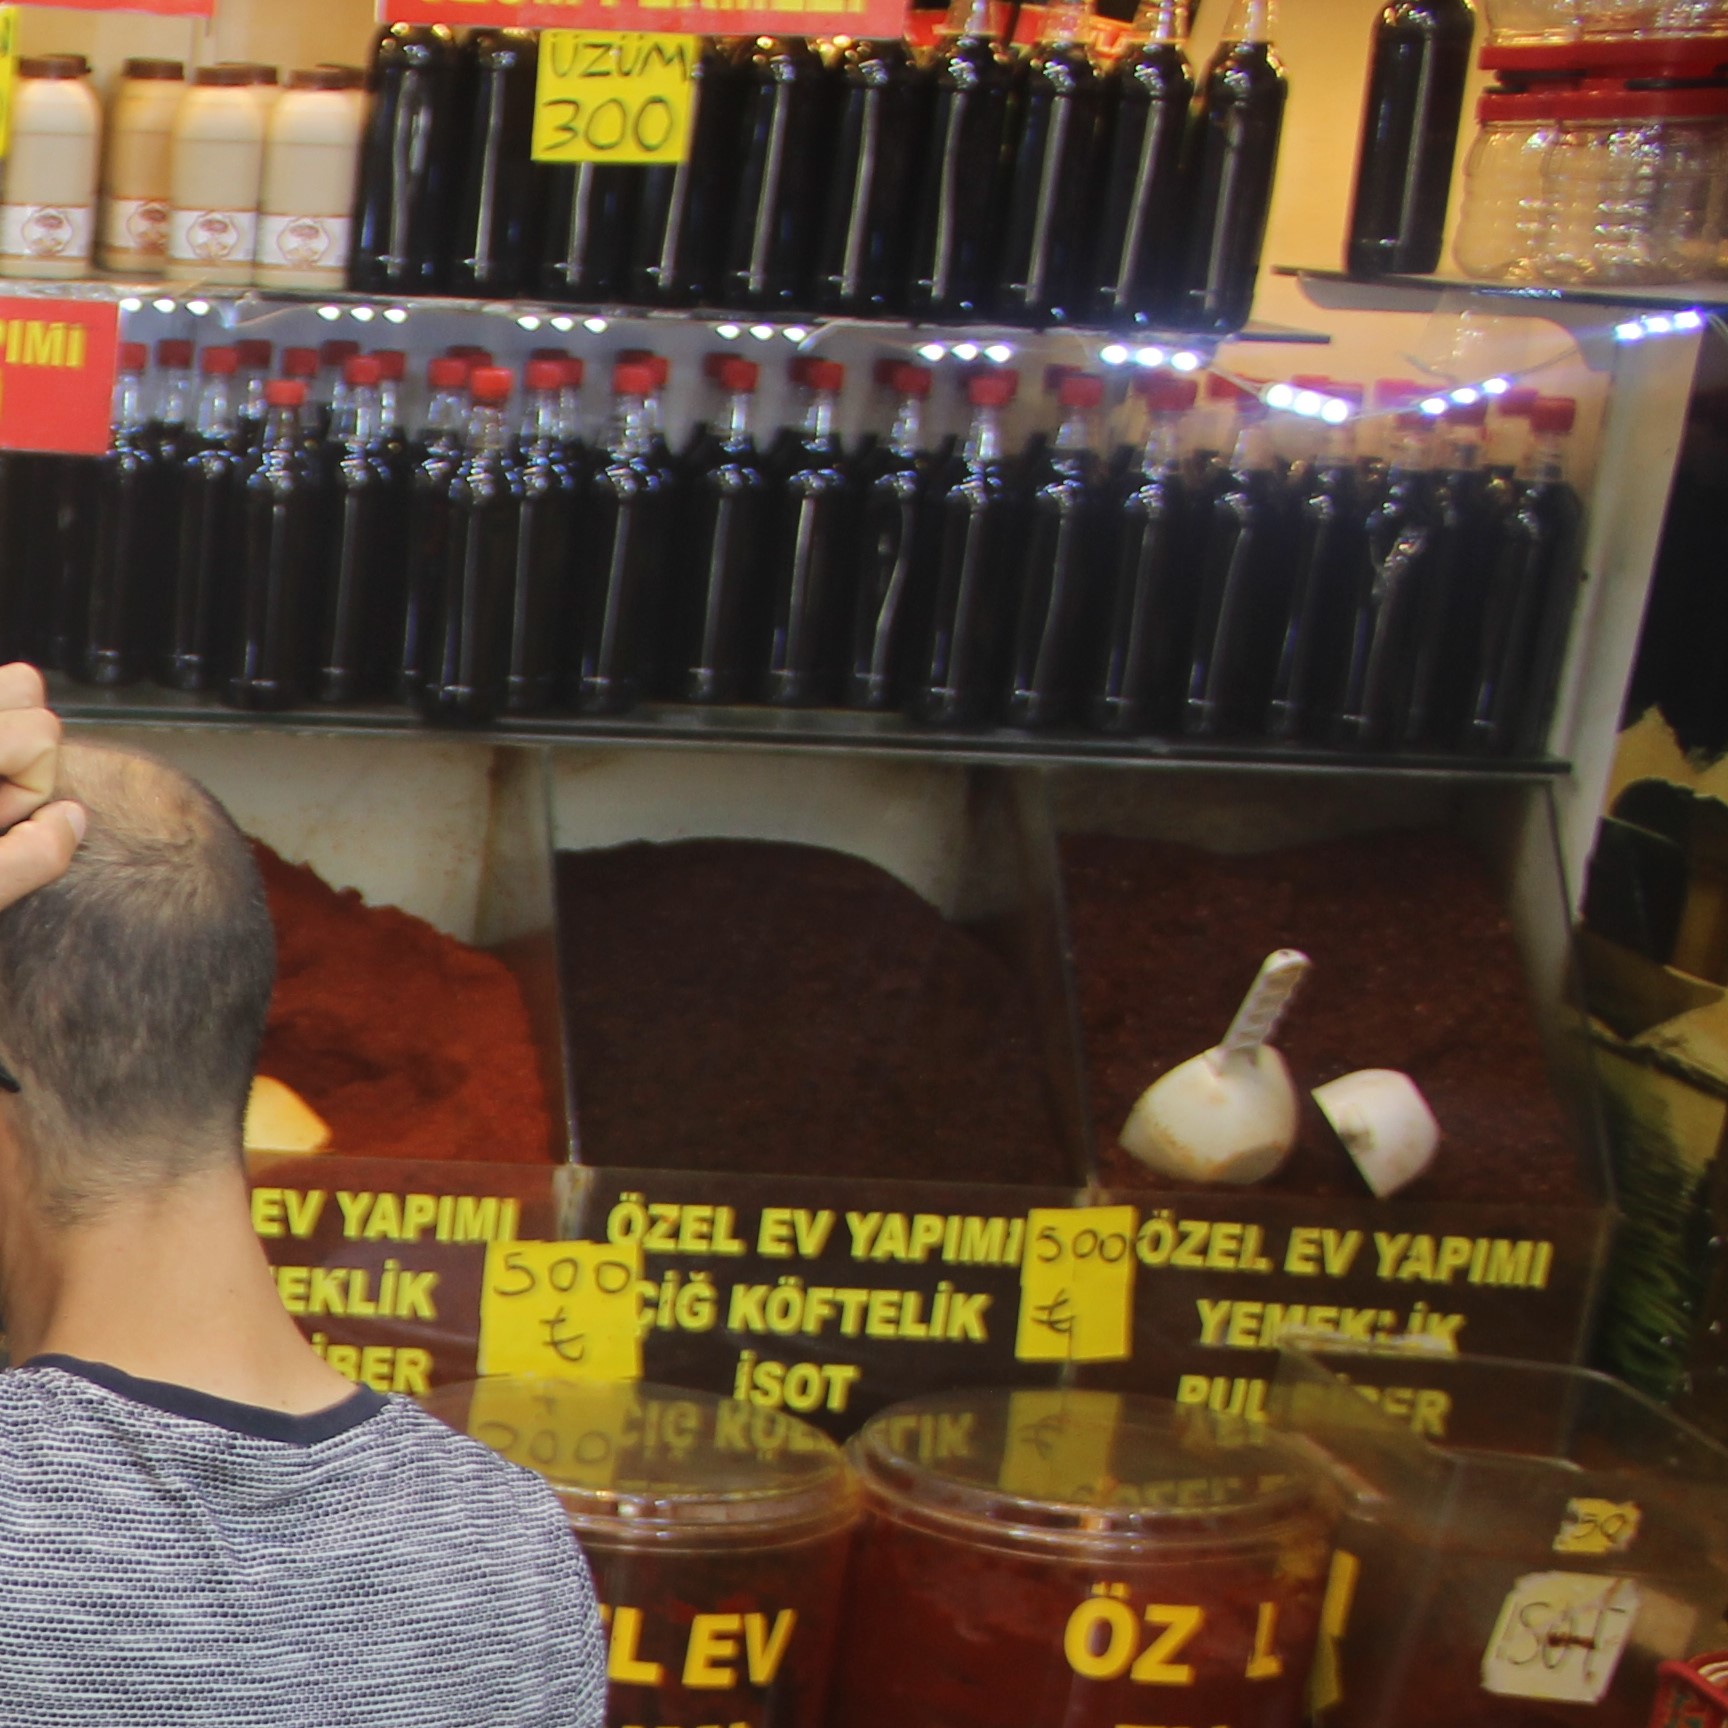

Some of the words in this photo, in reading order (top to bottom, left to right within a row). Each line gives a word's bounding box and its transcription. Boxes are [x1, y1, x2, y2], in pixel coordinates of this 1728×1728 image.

[542, 97, 674, 153] 300
[251, 1186, 323, 1239] EV
[337, 1190, 521, 1244] YAPIMI
[606, 1192, 745, 1255] ÖZEL
[756, 1207, 835, 1260] EV
[844, 1209, 1027, 1266] YAPIMI
[1032, 1229, 1129, 1266] 500
[494, 1252, 632, 1297] 500
[1136, 1208, 1273, 1275] ÖZEL
[1283, 1226, 1364, 1278] EV
[1374, 1231, 1555, 1290] YAPIMI
[726, 1276, 991, 1343] KÖFTELİK
[732, 1349, 861, 1414] İSOT
[682, 1608, 797, 1690] EV
